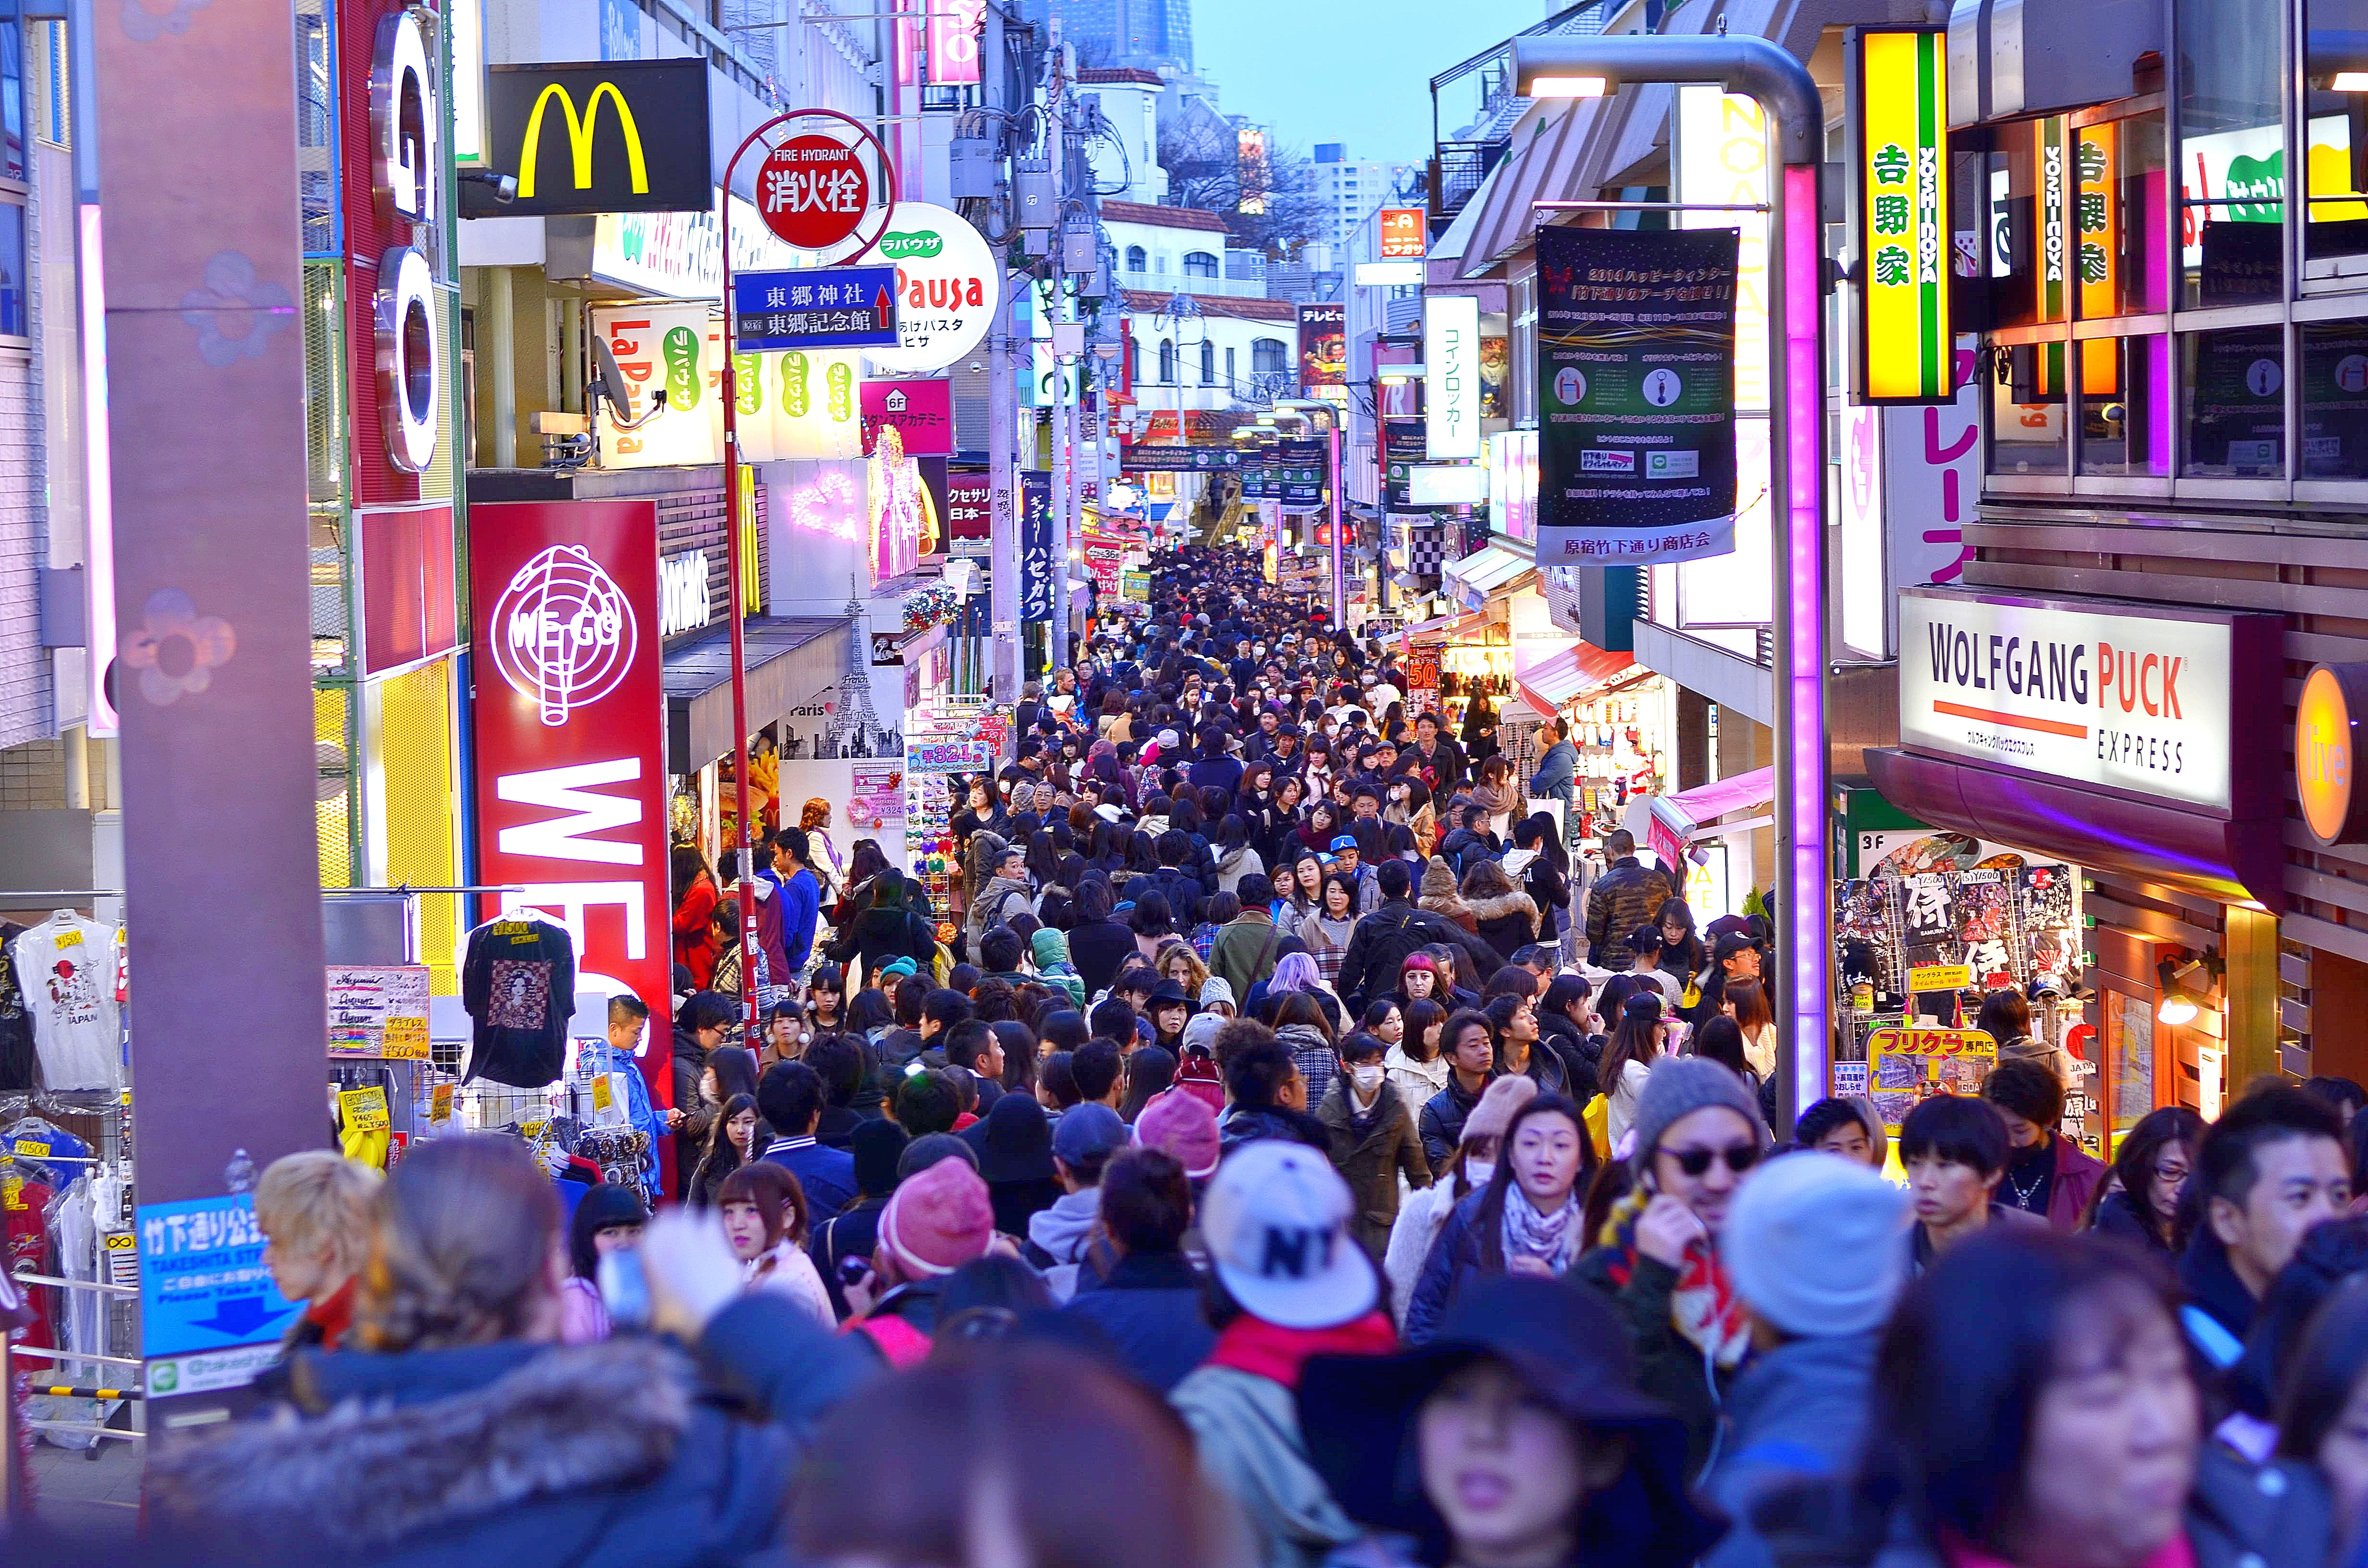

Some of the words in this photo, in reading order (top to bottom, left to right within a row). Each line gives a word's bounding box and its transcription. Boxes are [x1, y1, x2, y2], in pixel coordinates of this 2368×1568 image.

[775, 148, 798, 161] FIRE
[802, 148, 850, 161] HYDRANT
[766, 169, 862, 214] 消火栓
[1874, 143, 1911, 286] 吉野家
[882, 237, 941, 251] ラパウザ
[765, 283, 865, 307] 東郷神社
[767, 310, 871, 336] 東郷記念館
[672, 329, 693, 411] ラパウザ
[1446, 330, 1460, 437] コインロッカー
[889, 398, 904, 408] 6F
[950, 507, 992, 520] 日本一
[1565, 531, 1711, 555] 原宿竹下通り商店会
[1024, 547, 1050, 619] ハセガワ
[842, 675, 868, 684] French
[1409, 663, 1436, 686] 50
[1929, 622, 2087, 704] WOLFGANG
[2098, 642, 2183, 720] PUCK
[923, 745, 972, 764] ¥324
[2097, 729, 2183, 774] EXPRESS
[2306, 723, 2346, 786] live
[881, 806, 902, 814] ¥324
[1862, 834, 1885, 850] 3F
[493, 922, 528, 934] ¥1500
[1920, 928, 1945, 936] SAMURAI
[1916, 971, 1942, 980] サングラス
[385, 1045, 414, 1057] ¥500
[1879, 1030, 1965, 1054] プリクラ
[1965, 1040, 1994, 1053] 専門店
